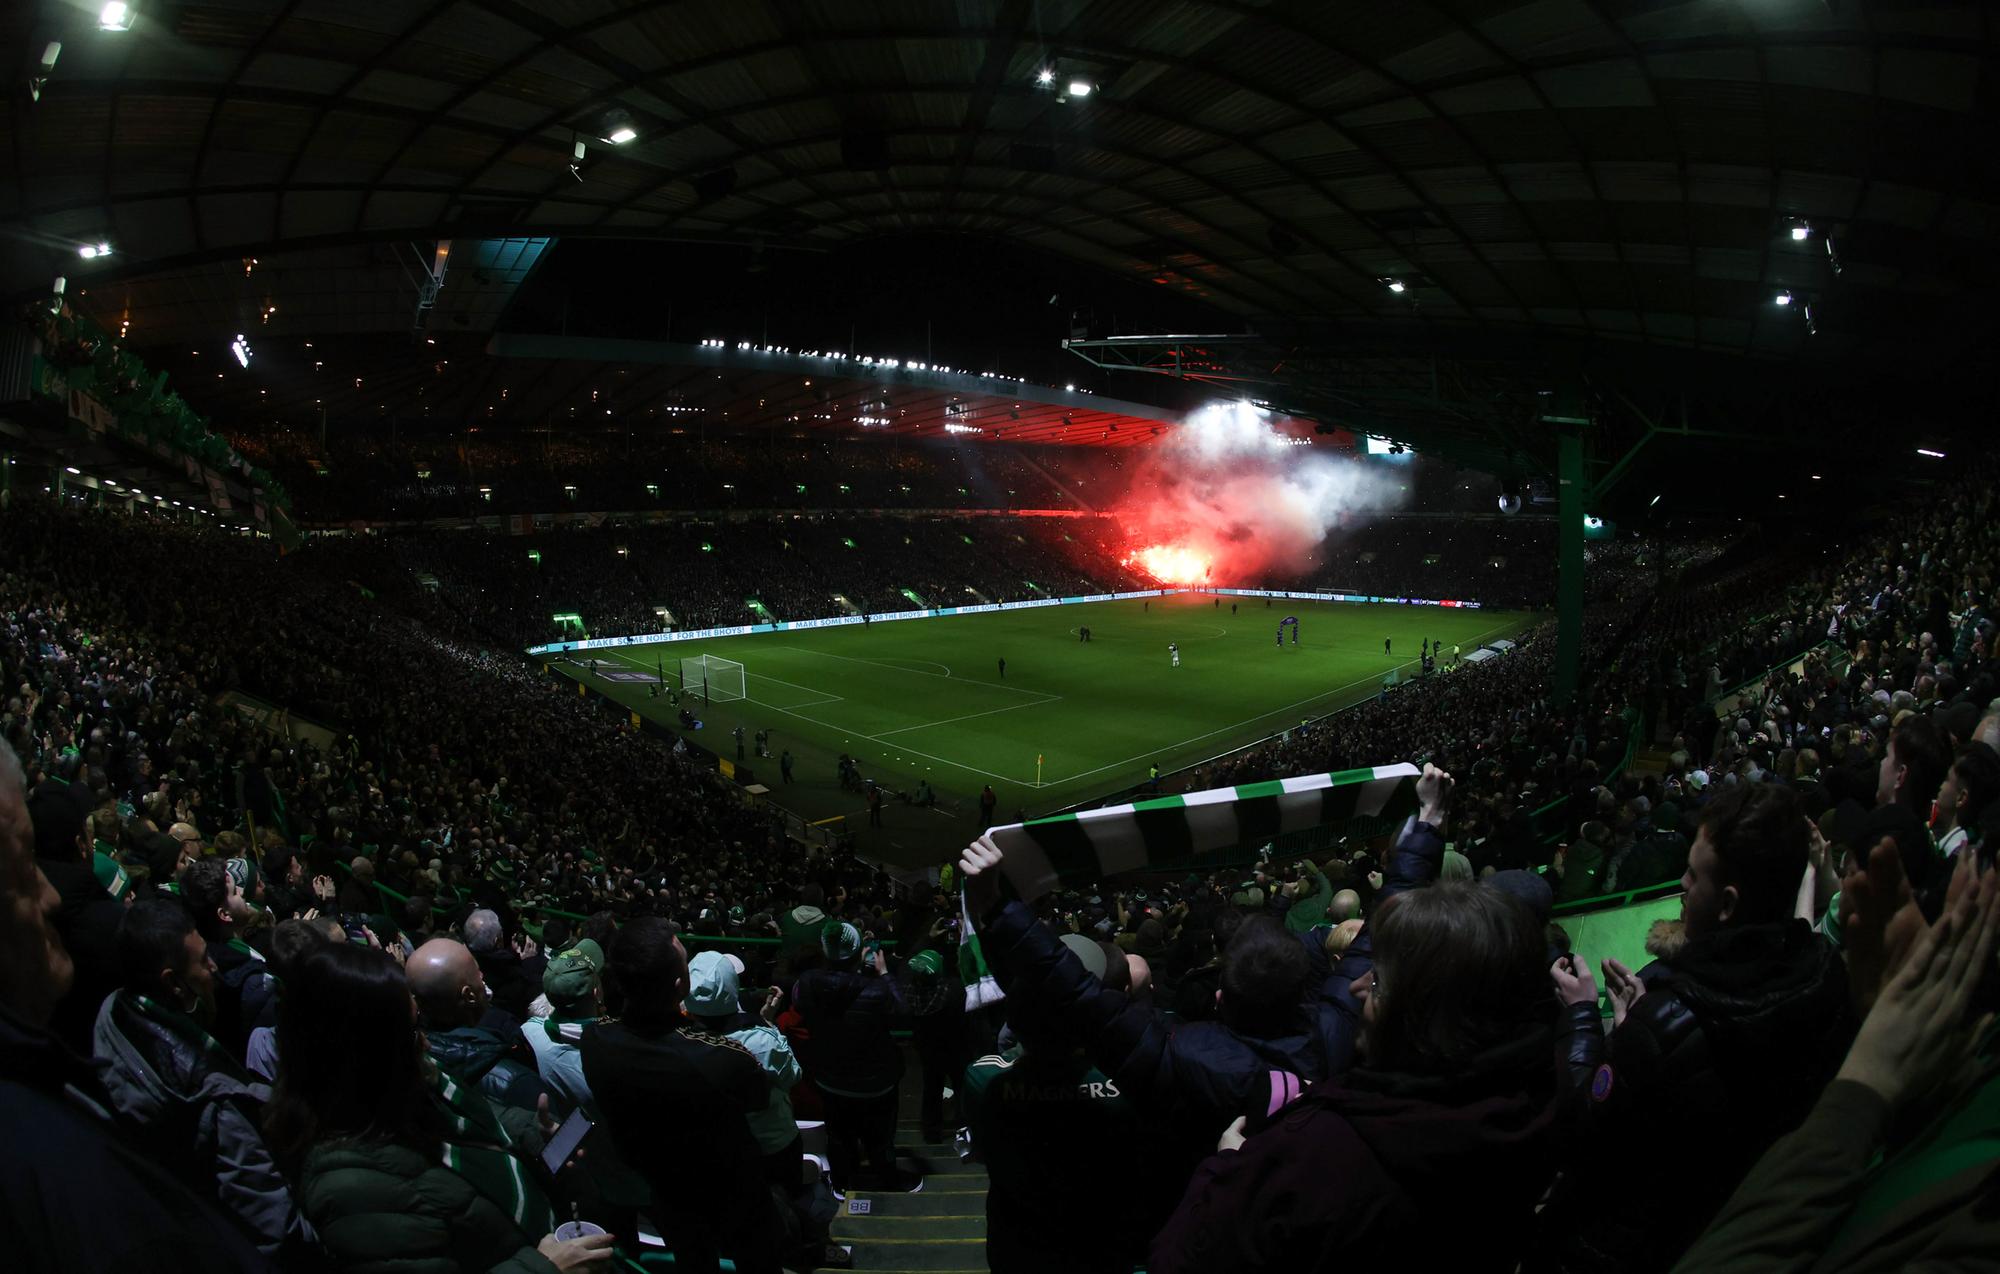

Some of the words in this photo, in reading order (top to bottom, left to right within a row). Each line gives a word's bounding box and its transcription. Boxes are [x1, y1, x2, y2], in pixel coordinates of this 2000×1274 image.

[795, 621, 817, 629] MAKE
[885, 612, 897, 620] THE
[587, 639, 614, 648] MAKE
[647, 634, 673, 643] NOISE
[714, 627, 745, 635] BHOYS!
